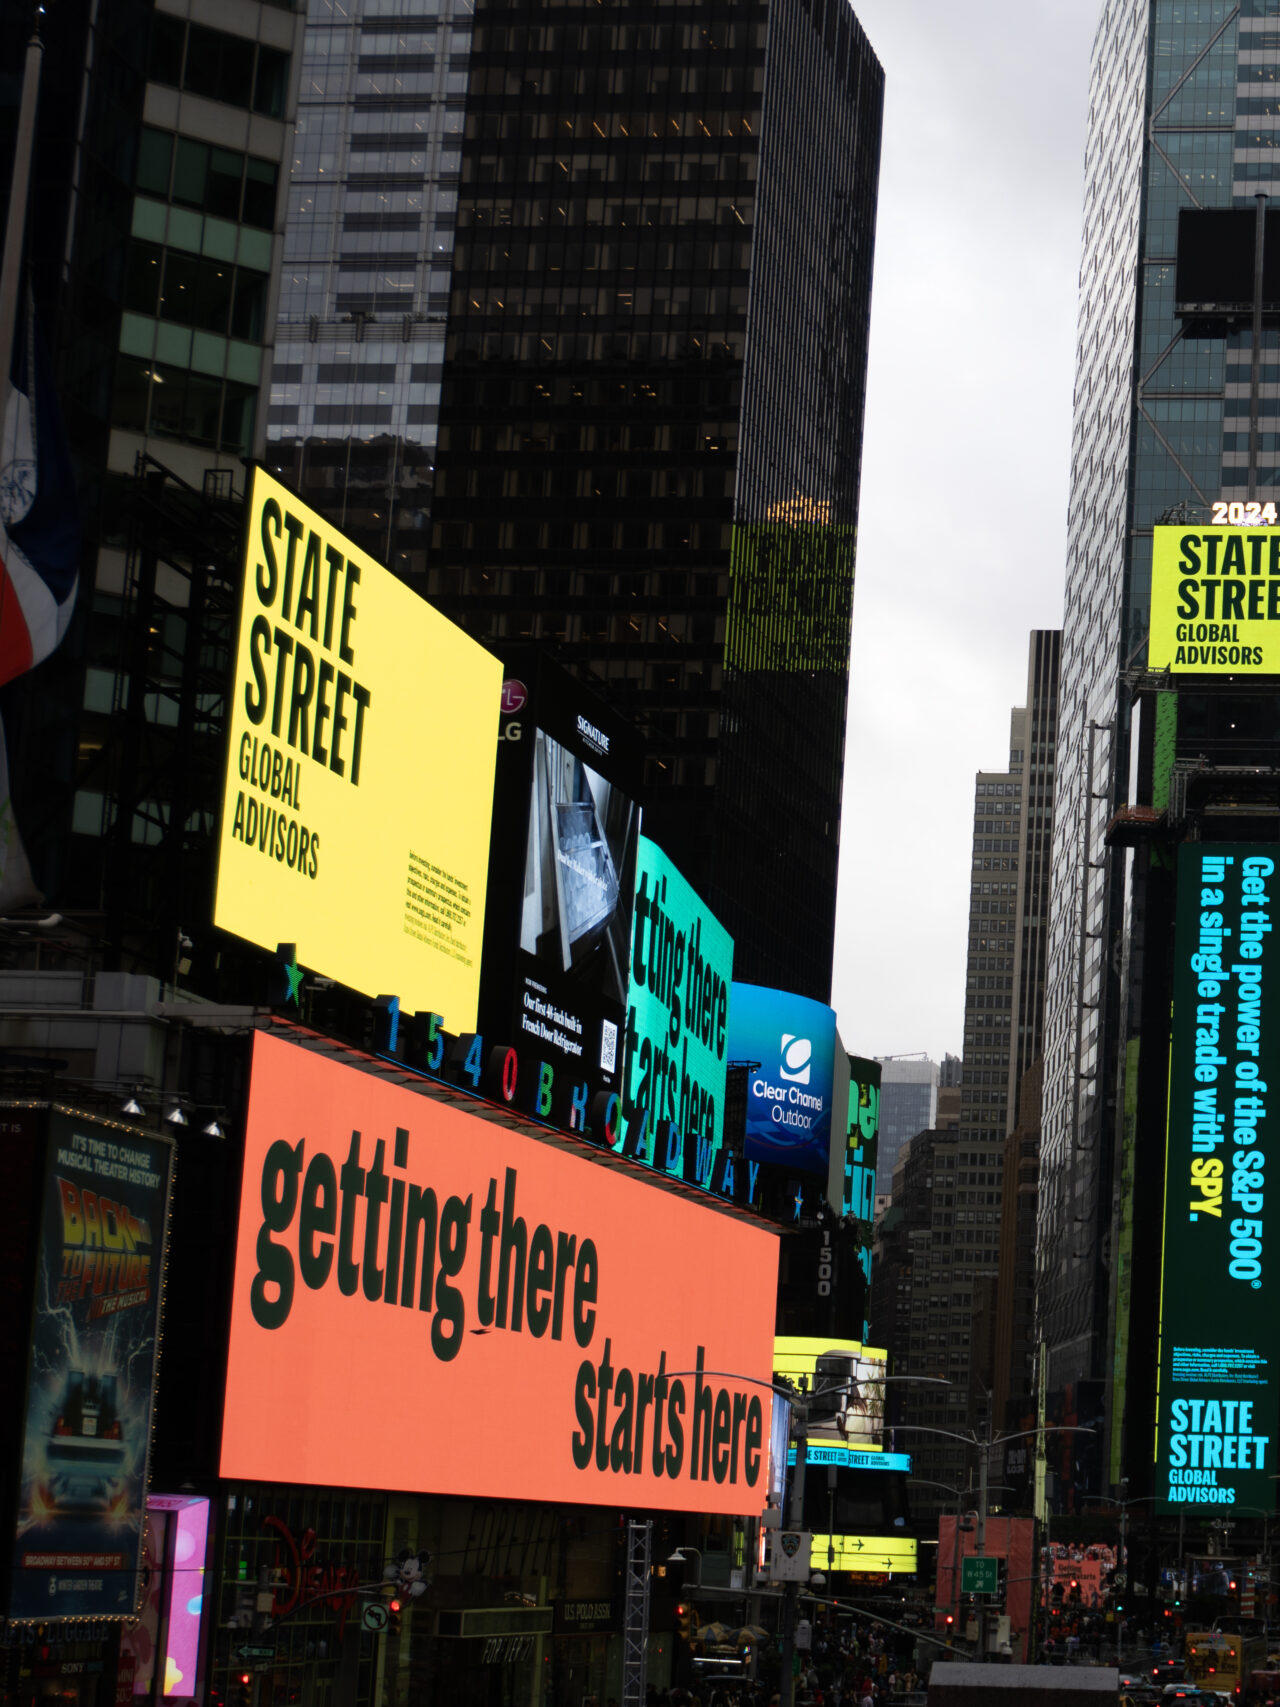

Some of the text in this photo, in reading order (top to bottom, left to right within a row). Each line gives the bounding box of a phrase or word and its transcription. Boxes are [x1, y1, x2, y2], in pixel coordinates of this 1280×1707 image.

[1212, 502, 1277, 525] 2024
[255, 497, 361, 666] STATE
[1175, 623, 1240, 643] GLOBAL
[1175, 646, 1263, 666] ADVISORS
[245, 614, 371, 786] STREET
[577, 714, 611, 751] SIGNATURE
[238, 731, 301, 811] GLOBAL
[231, 790, 320, 881] ADVISORS
[1241, 856, 1275, 906] Get
[1239, 911, 1272, 959] the
[523, 991, 535, 1011] Our
[535, 998, 547, 1018] first
[684, 917, 728, 1061] there
[1231, 963, 1262, 1057] power
[522, 1013, 583, 1057] French Door Refrigerator
[1189, 856, 1234, 1222] in a single trade with SPY.
[680, 1036, 716, 1143] here
[753, 1080, 787, 1103] Clear
[788, 1085, 823, 1112] Channel
[1235, 1061, 1268, 1092] of
[772, 1104, 812, 1129] Outdoor
[1233, 1096, 1266, 1145] the
[57, 1149, 162, 1190] MUSICAL THEATER HISTORY
[72, 1134, 151, 1168] IT'S TIME TO CHANGE
[1231, 1150, 1265, 1213] S&P
[56, 1175, 140, 1252] BACK
[251, 1128, 597, 1361] getting there
[817, 1230, 832, 1296] 1500
[56, 1280, 80, 1303] THE
[63, 1250, 151, 1298] TO FUTURE
[101, 1291, 149, 1316] THE MUSICAL
[572, 1338, 762, 1487] starts here
[1170, 1398, 1253, 1434] STATE
[814, 1451, 837, 1462] STREET
[1169, 1433, 1269, 1470] STREET
[1168, 1469, 1218, 1486] GLOBAL
[1168, 1486, 1236, 1504] ADVISORS
[47, 1622, 109, 1642] LUGGAGE
[61, 1663, 84, 1674] SONY
